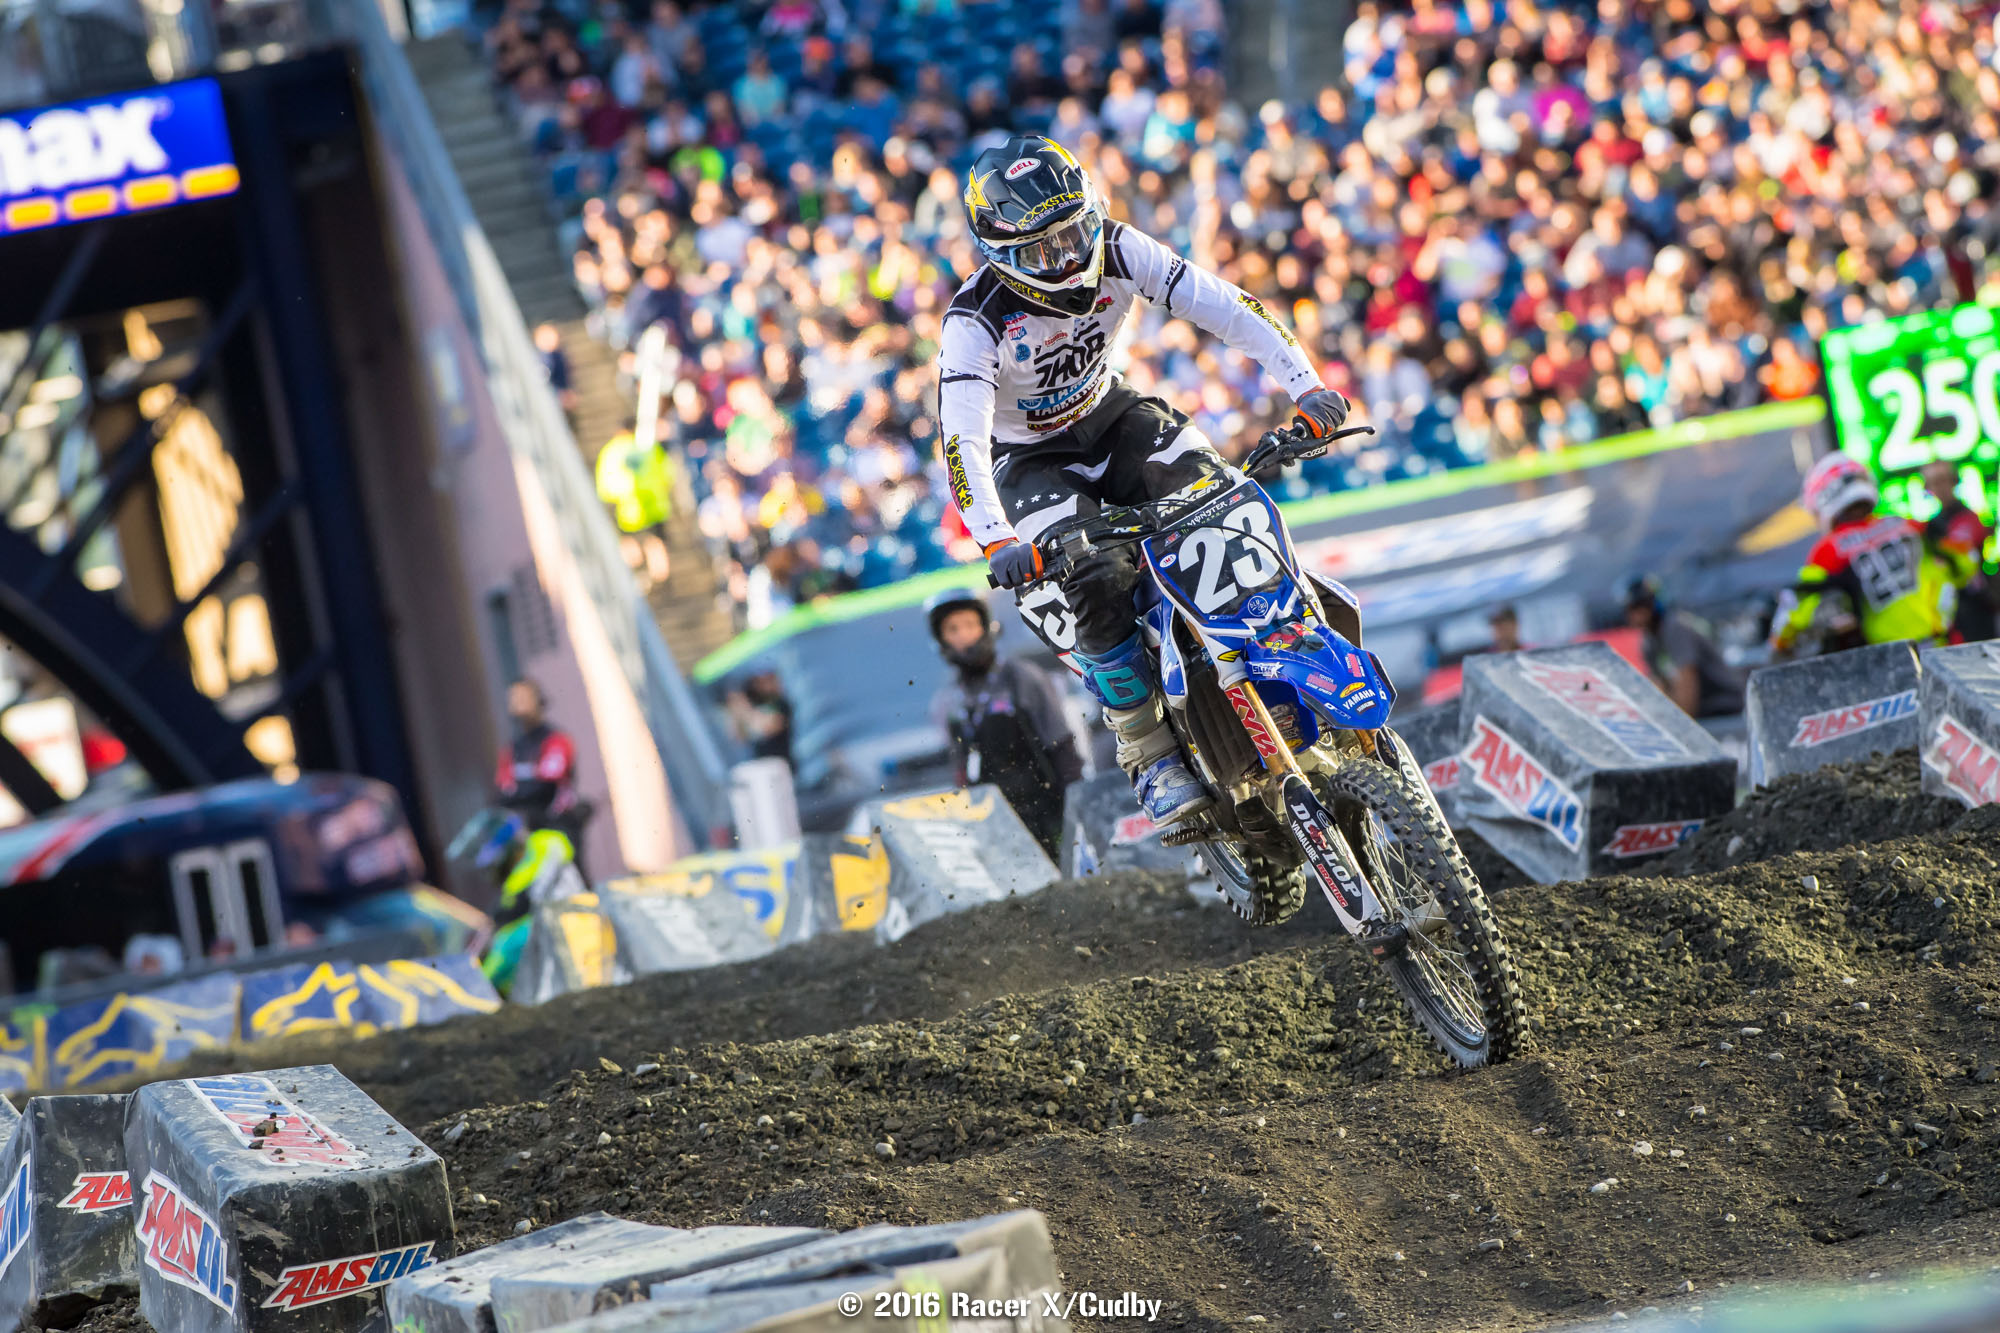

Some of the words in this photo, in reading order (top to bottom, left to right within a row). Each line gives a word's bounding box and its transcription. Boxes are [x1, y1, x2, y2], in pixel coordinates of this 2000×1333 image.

[1009, 160, 1035, 176] BELL
[1068, 276, 1083, 286] BELL
[1187, 501, 1227, 527] MONSTER
[1178, 502, 1280, 614] 23
[1225, 686, 1279, 759] KYB
[1342, 689, 1376, 710] YAMAHA
[1796, 690, 1918, 746] AMSOIL
[1466, 720, 1584, 850] AMSOIL
[1290, 820, 1320, 863] YAMALUBE
[1317, 864, 1349, 908] BRAKING
[140, 1178, 236, 1312] AMSOIL
[266, 1242, 434, 1309] AMSOIL
